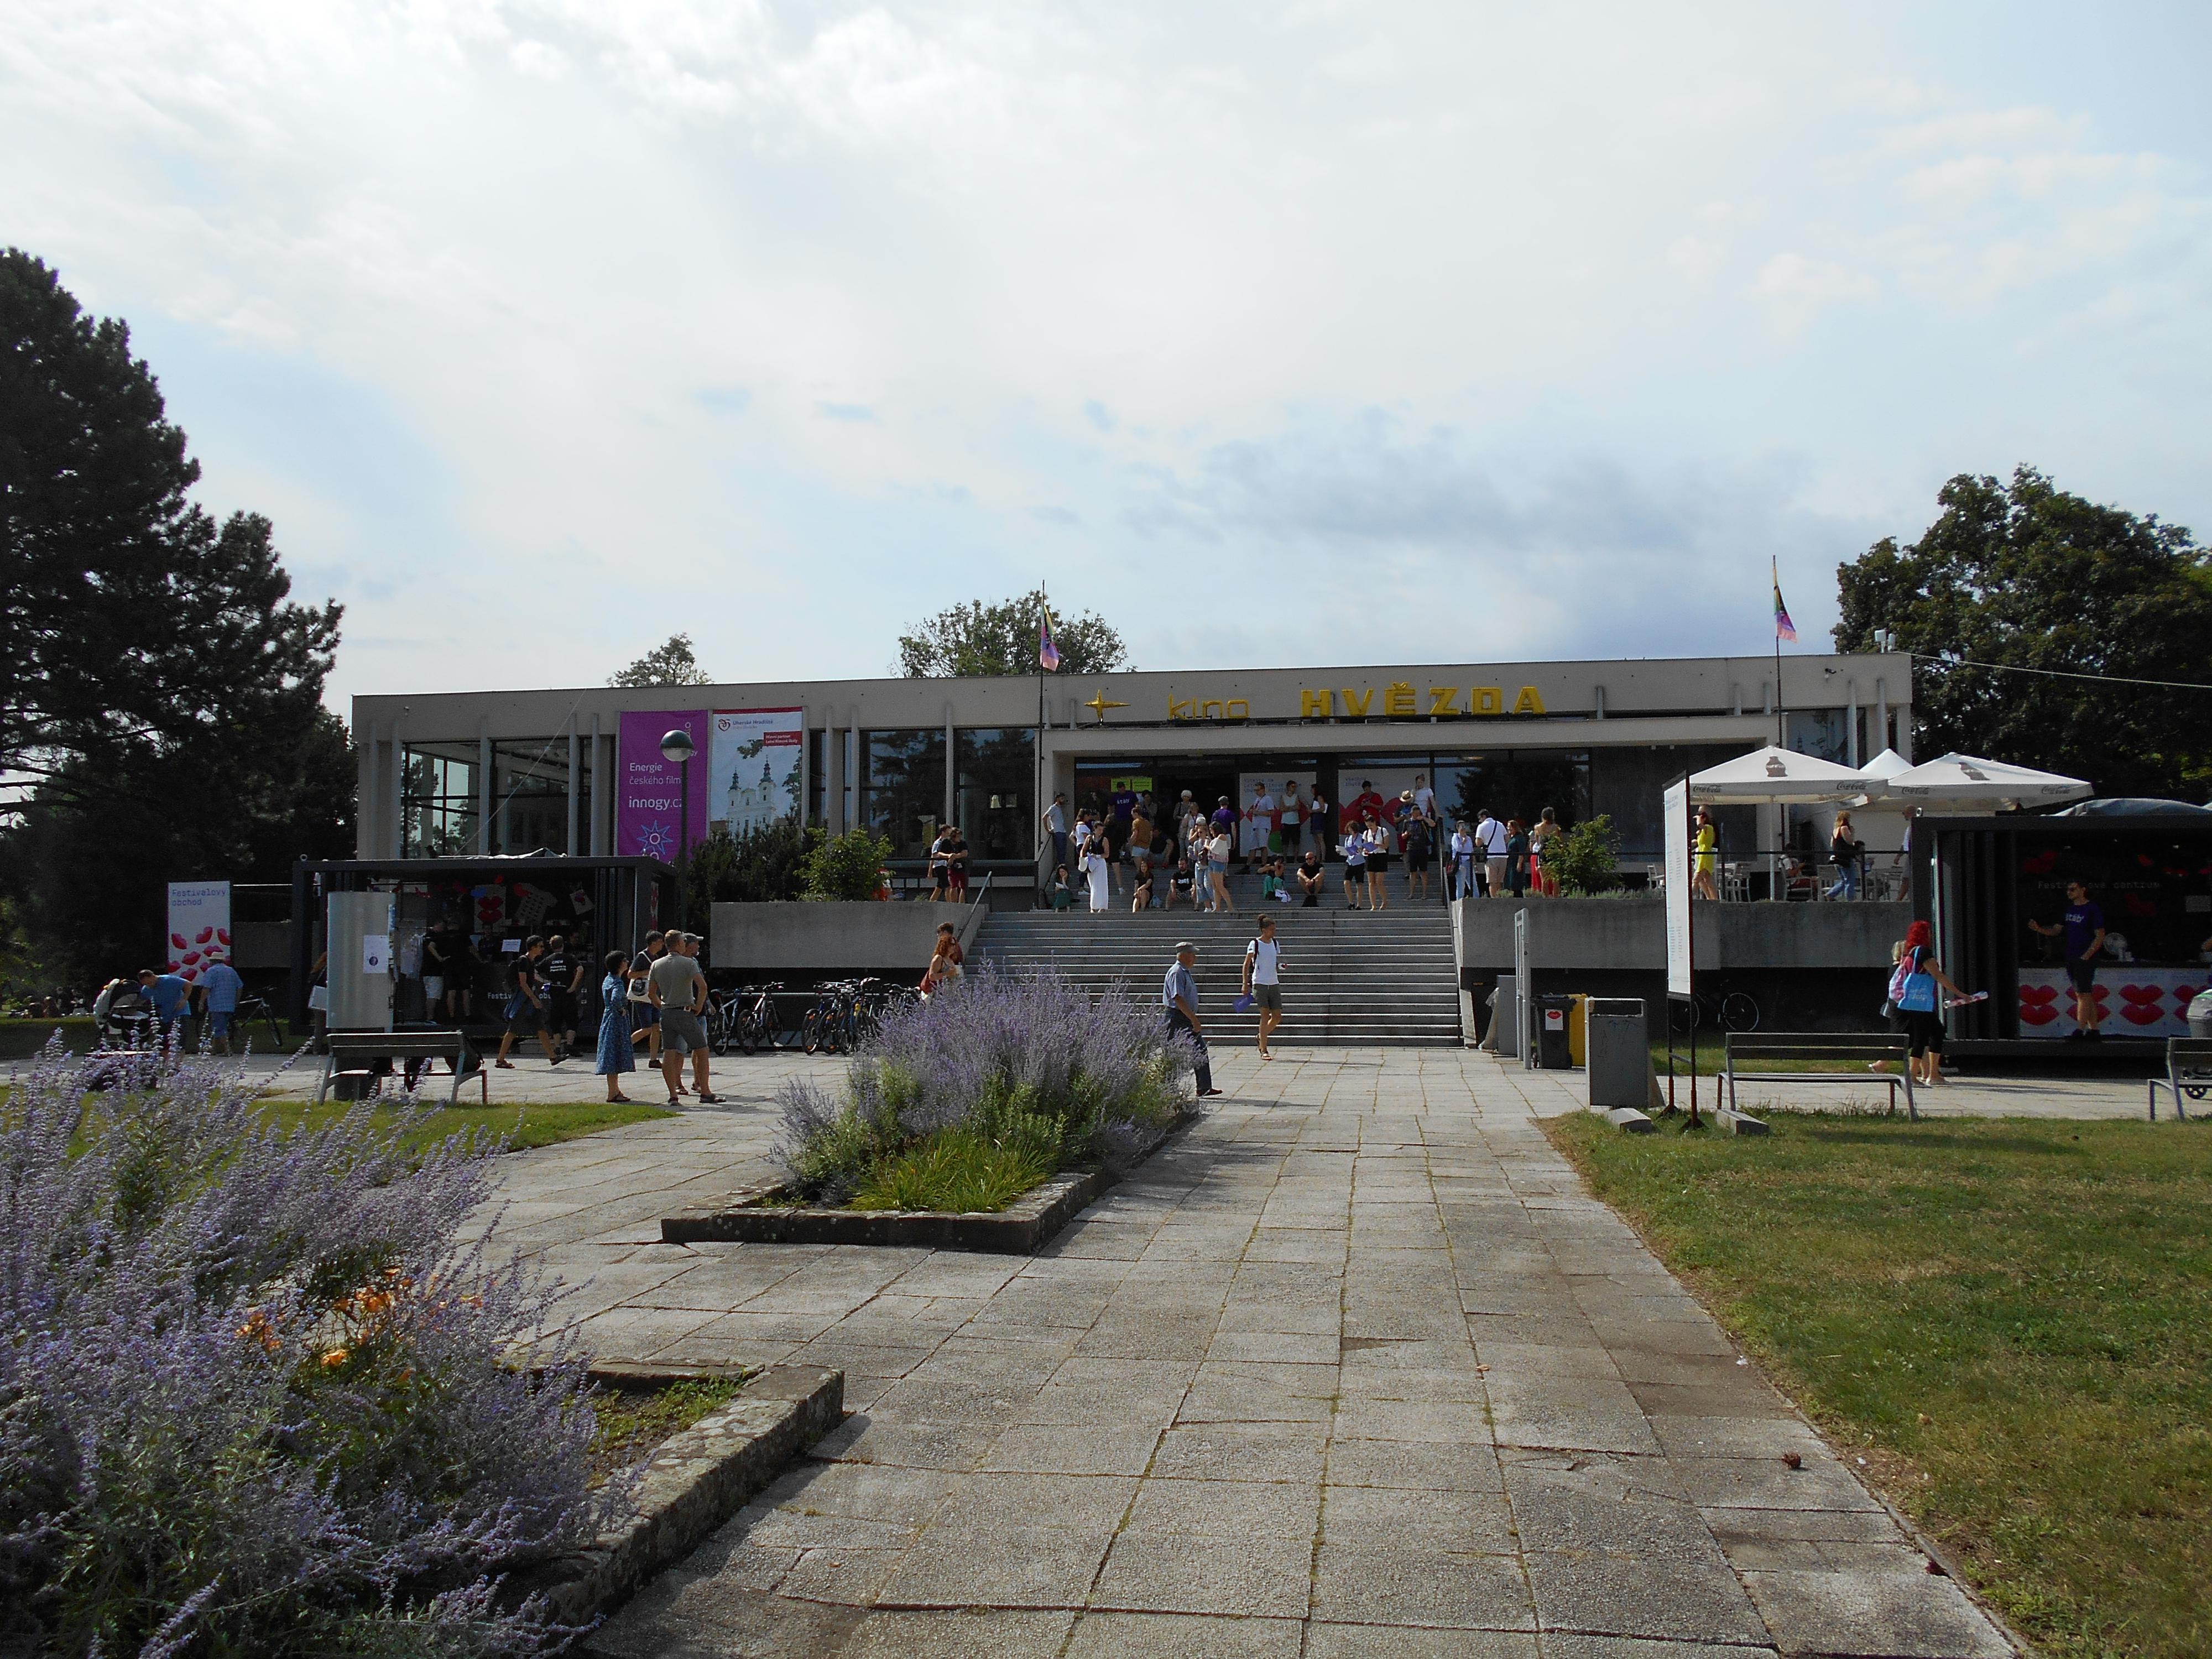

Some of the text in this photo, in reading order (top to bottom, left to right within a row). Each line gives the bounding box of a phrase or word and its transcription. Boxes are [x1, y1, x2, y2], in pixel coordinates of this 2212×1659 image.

[1169, 682, 1547, 720] kino HVĚZDA
[630, 763, 662, 773] Energie
[629, 775, 682, 785] českého film
